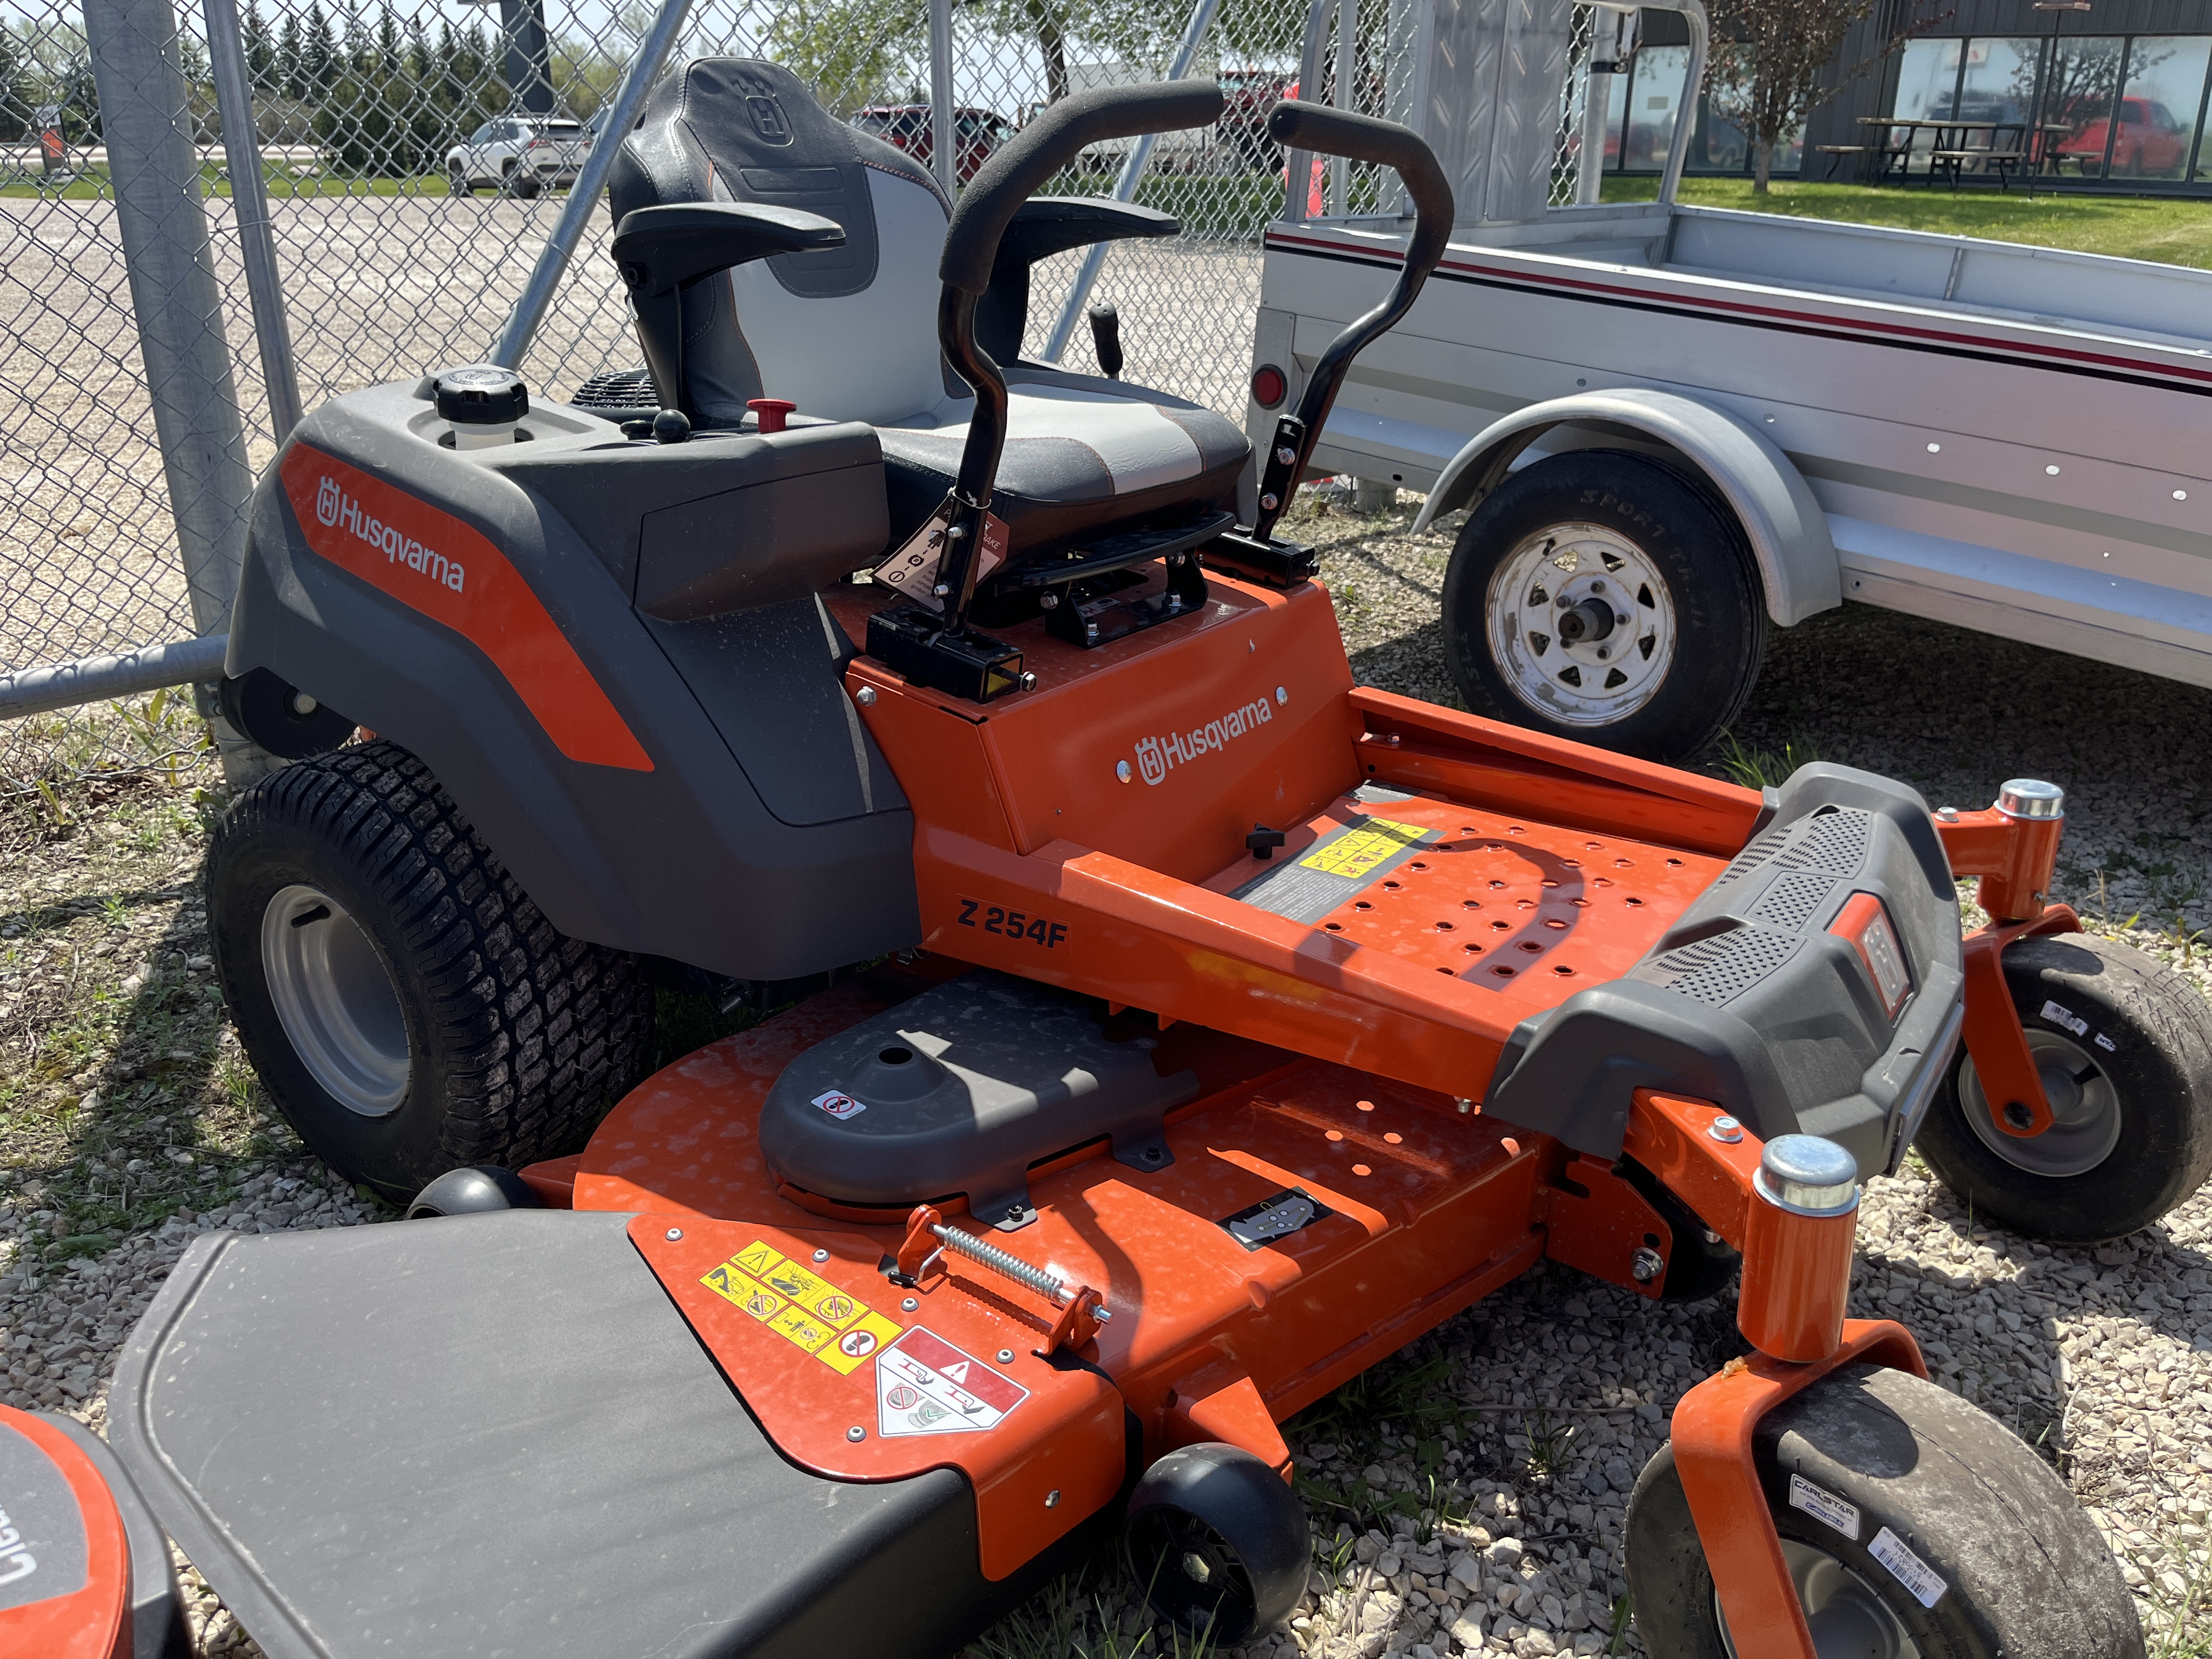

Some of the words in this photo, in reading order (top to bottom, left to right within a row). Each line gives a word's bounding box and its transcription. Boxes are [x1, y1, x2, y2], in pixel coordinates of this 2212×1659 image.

[338, 493, 465, 593] Husqvarna
[1161, 697, 1272, 769] Husqvarna
[957, 899, 979, 927] Z
[984, 907, 1068, 949] 254F
[1794, 1480, 1855, 1517] CARLSTAR
[1807, 1503, 1843, 1527] CARLISLE
[1895, 1551, 1922, 1578] 5100521
